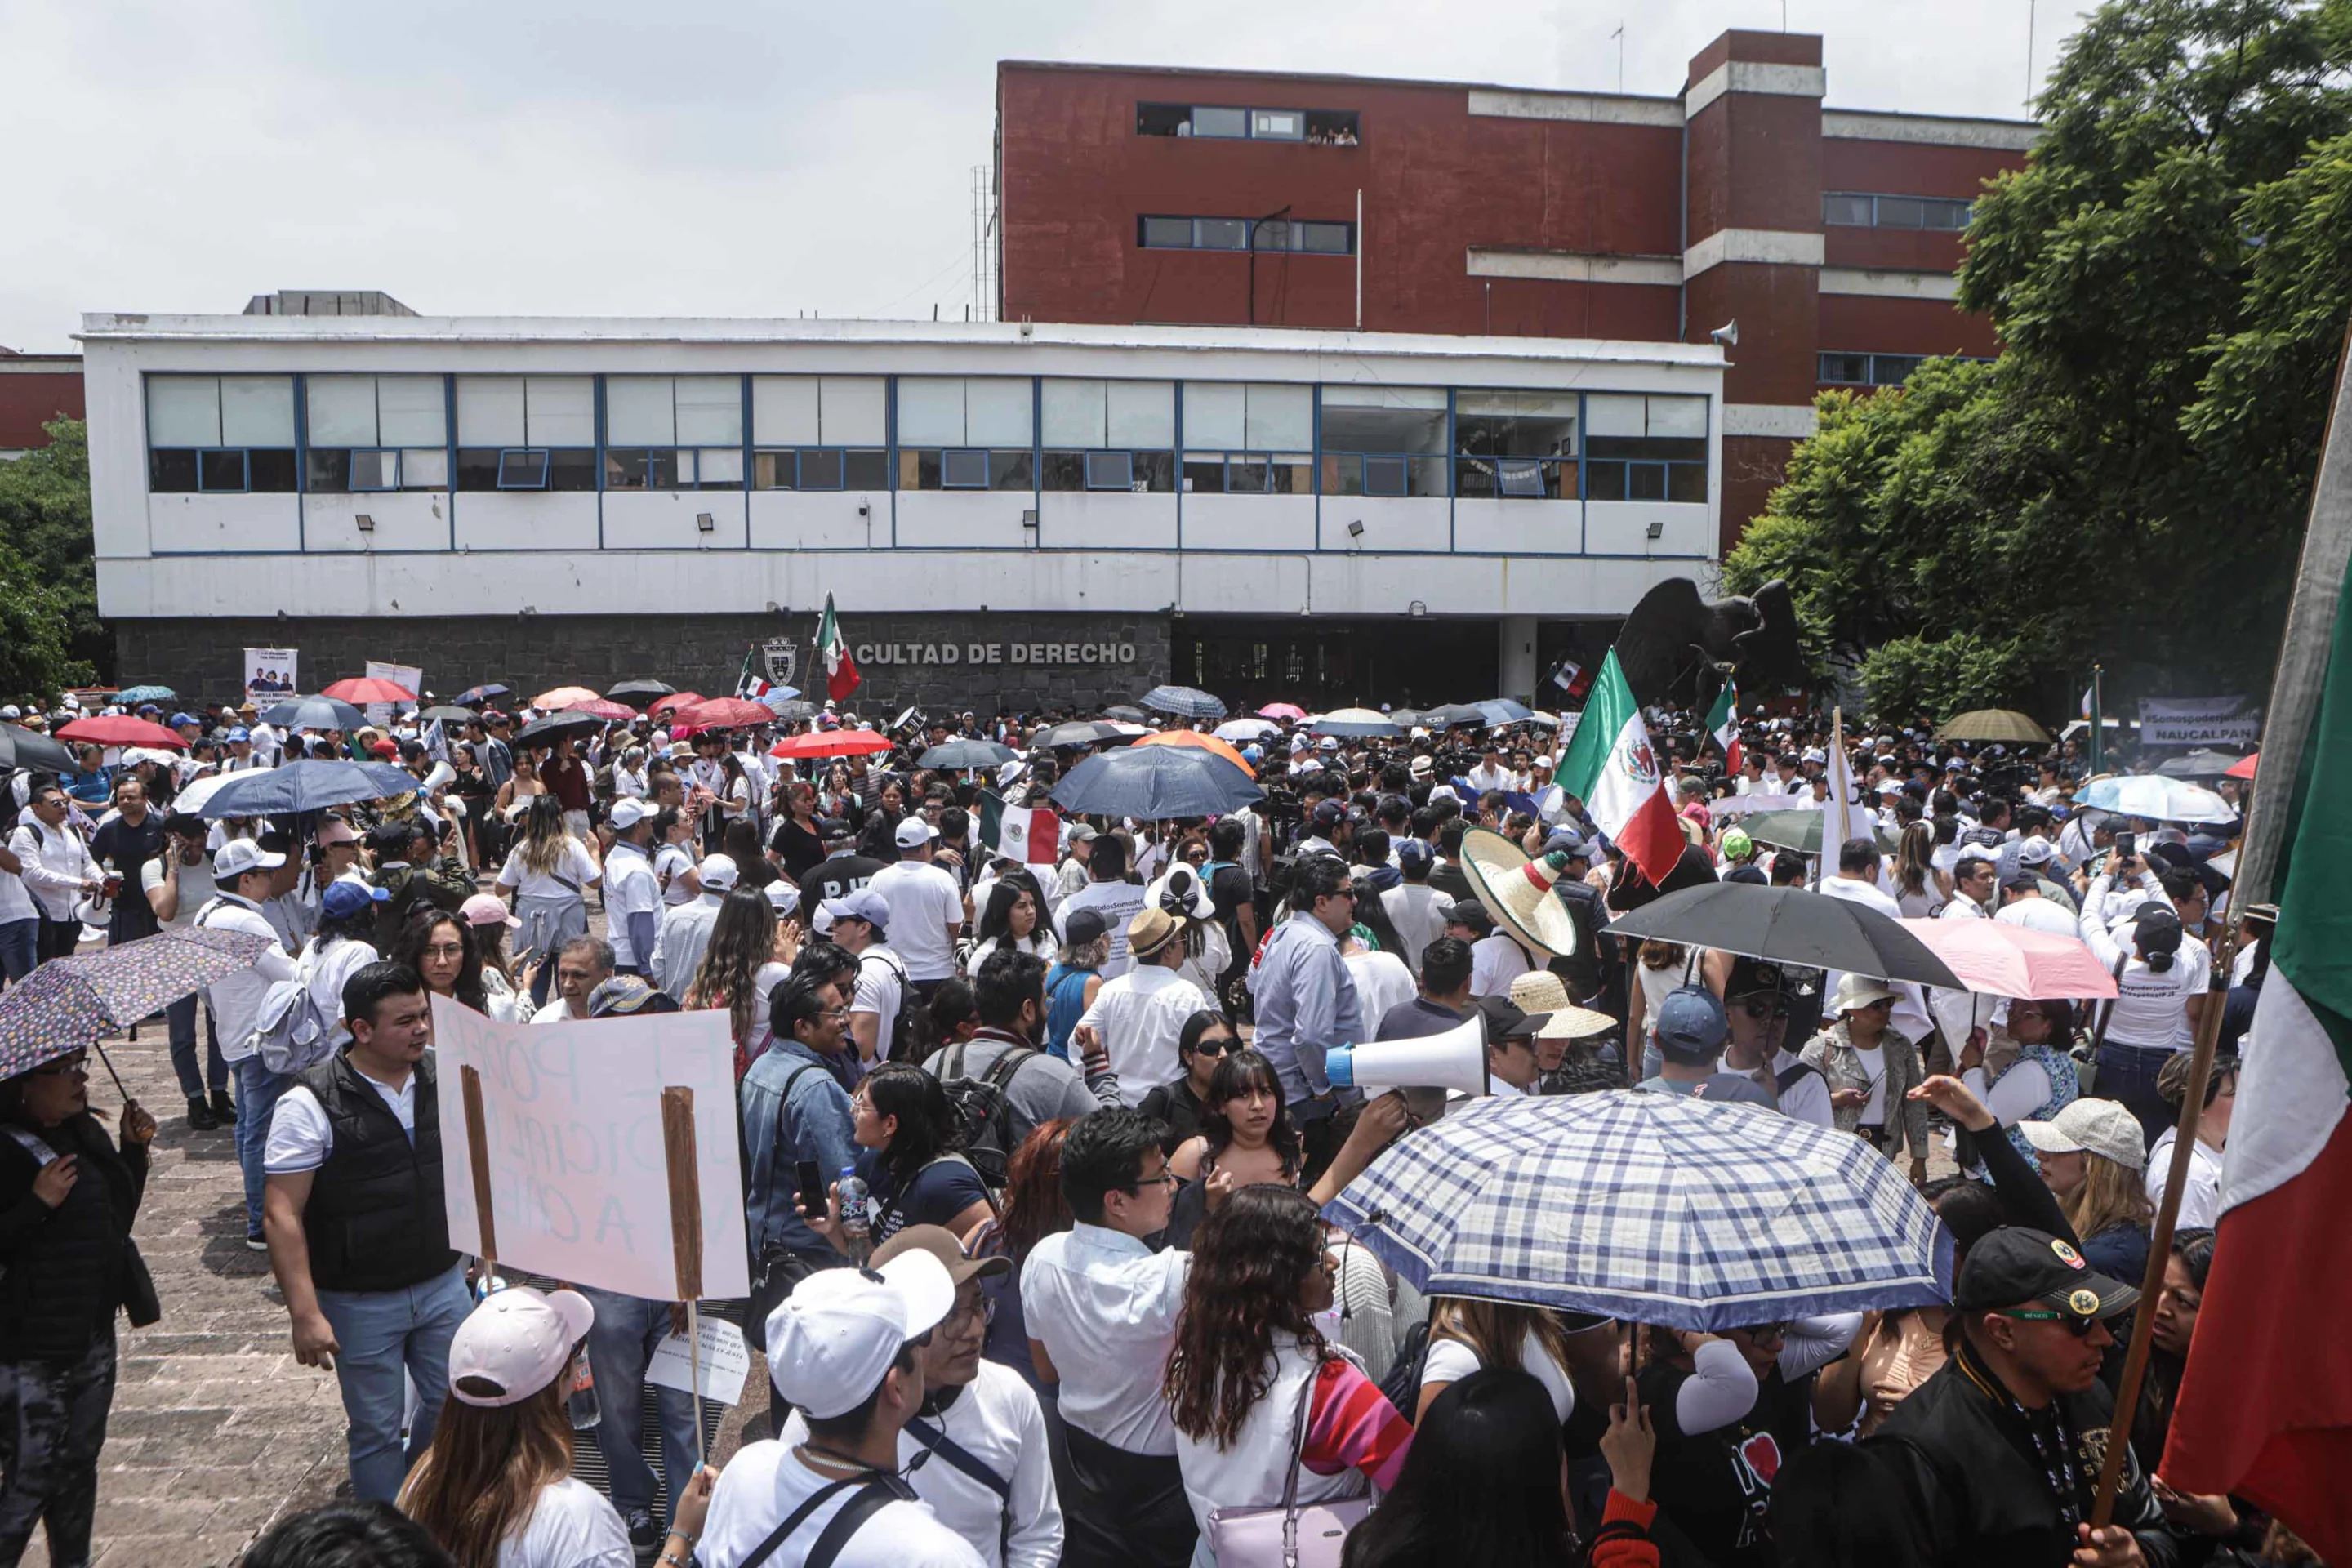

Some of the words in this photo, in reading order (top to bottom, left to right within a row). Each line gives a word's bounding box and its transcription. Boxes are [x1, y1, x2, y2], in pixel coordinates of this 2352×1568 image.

[969, 644, 1003, 664] DE
[1010, 643, 1136, 664] DERECHO
[2156, 728, 2252, 740] NAUCALPAN
